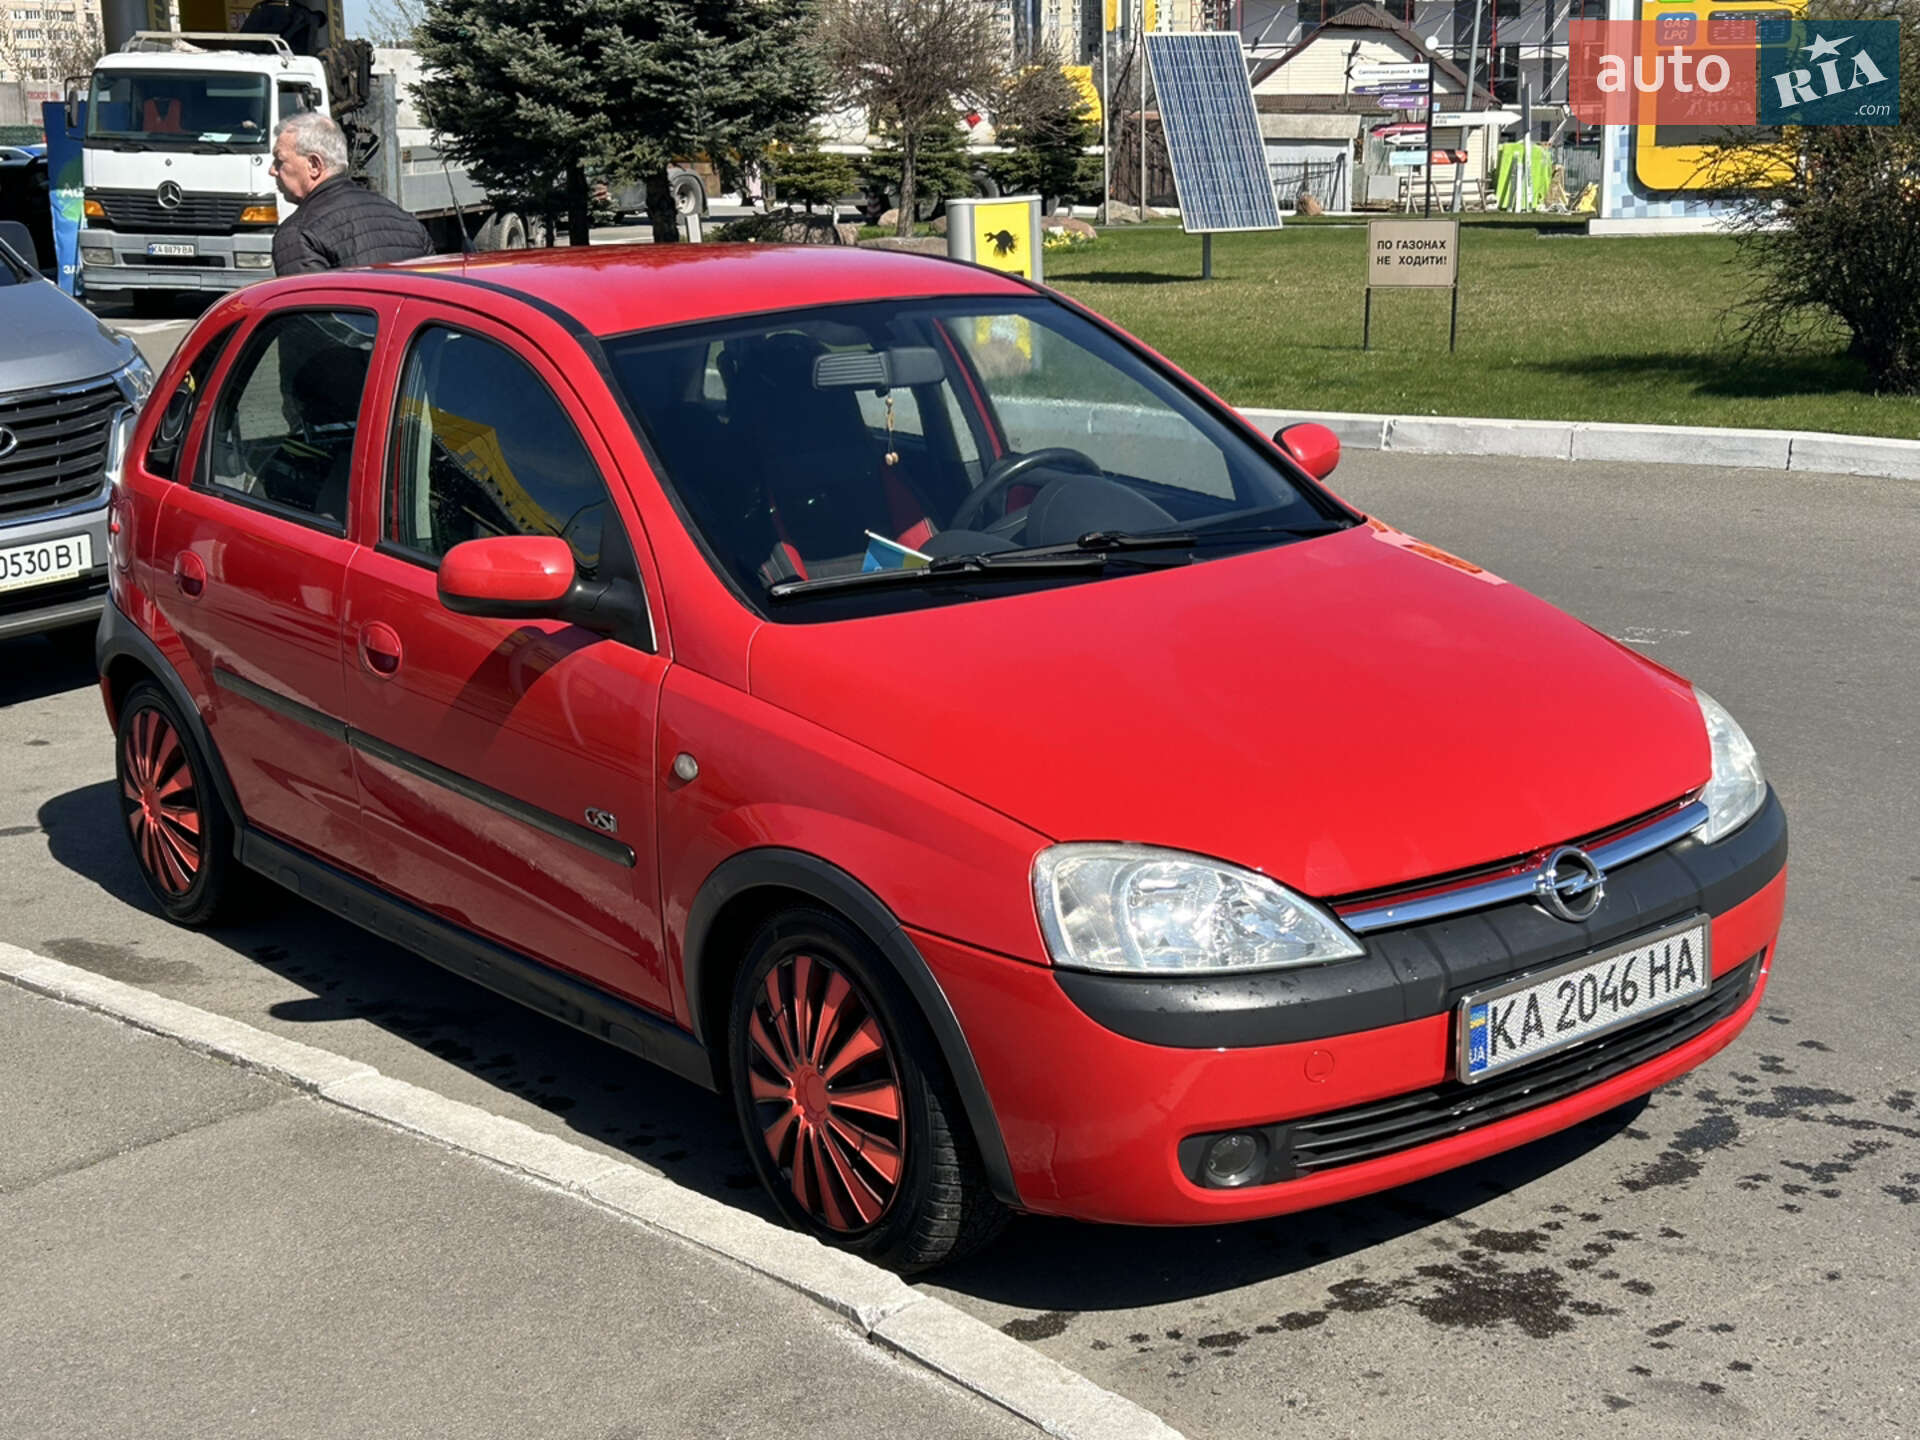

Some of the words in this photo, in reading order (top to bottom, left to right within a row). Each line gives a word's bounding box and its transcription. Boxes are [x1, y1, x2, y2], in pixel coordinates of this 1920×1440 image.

[1663, 17, 1690, 29] GAS
[1663, 29, 1688, 41] LPG
[1377, 240, 1393, 250] ПО
[1396, 240, 1446, 250] ГАЗОНАХ
[1376, 256, 1391, 265] НЕ
[1398, 255, 1447, 266] ХОДИТИ!
[1490, 992, 1545, 1057] KA
[1556, 955, 1640, 1033] 2046
[1649, 937, 1697, 999] HA
[1468, 1045, 1486, 1065] UA
